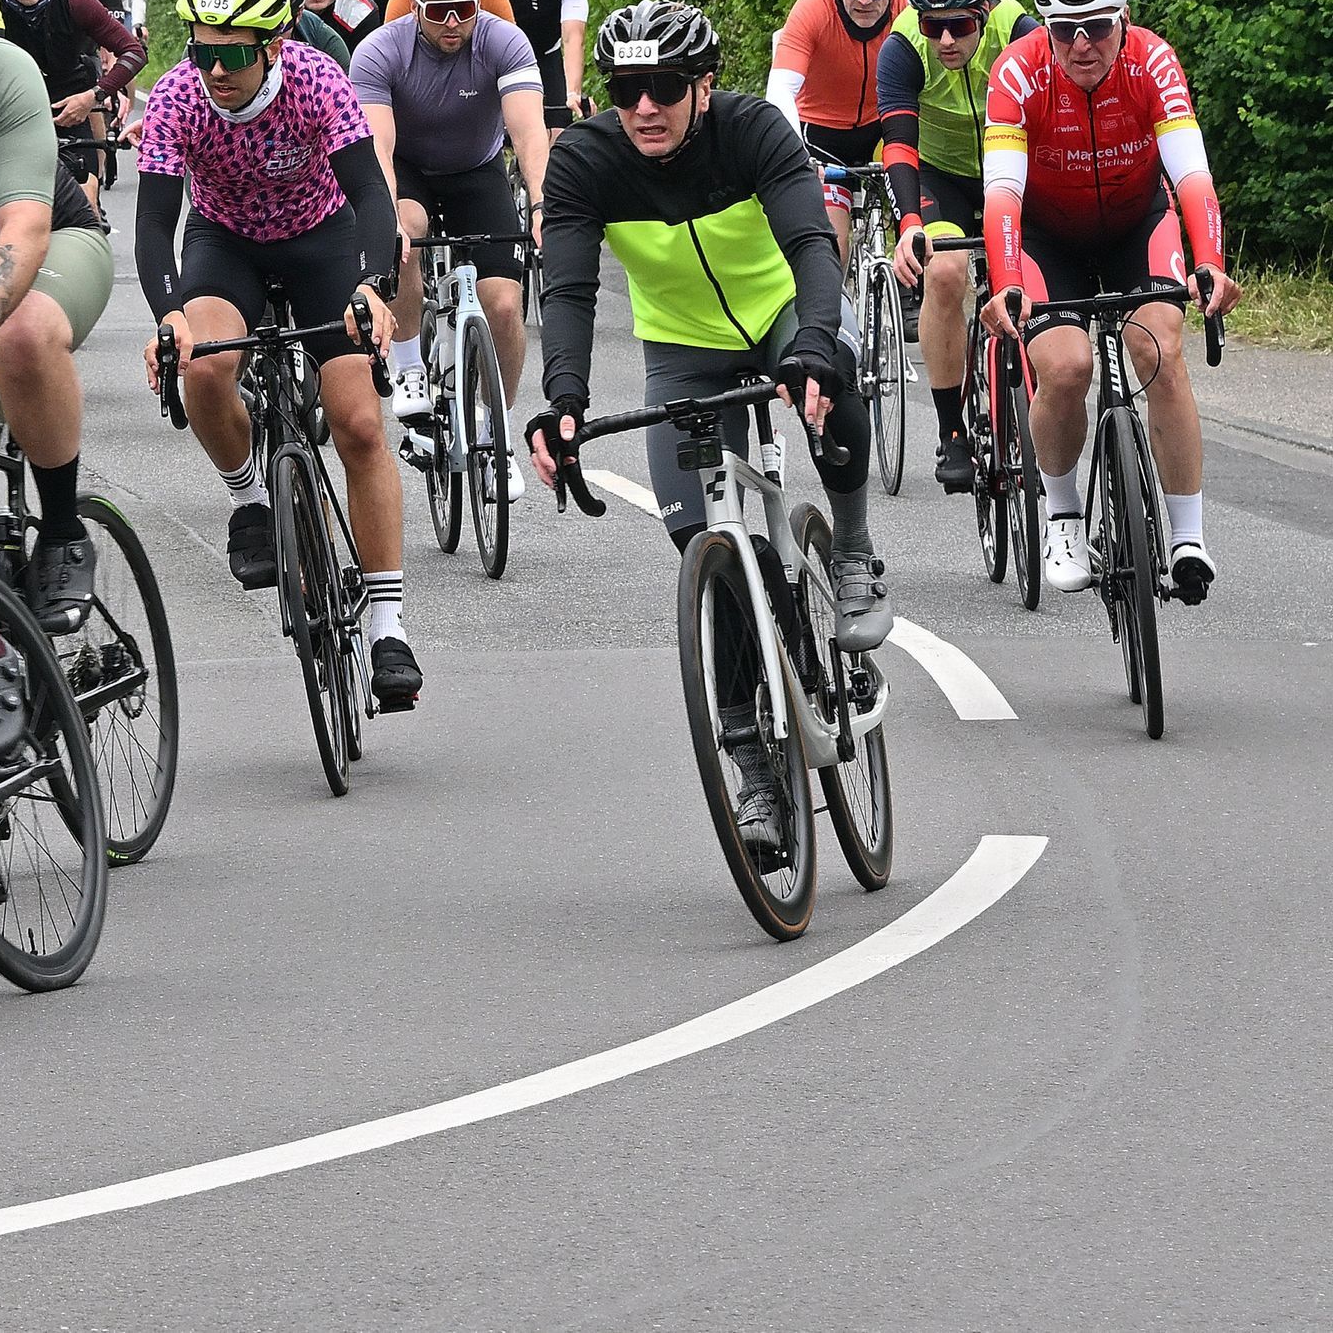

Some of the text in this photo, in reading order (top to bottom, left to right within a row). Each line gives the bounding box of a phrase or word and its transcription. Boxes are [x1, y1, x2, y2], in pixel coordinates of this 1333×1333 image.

[618, 46, 652, 59] 6320
[1067, 133, 1154, 162] Marcel Wüst
[1105, 335, 1124, 399] GIANT
